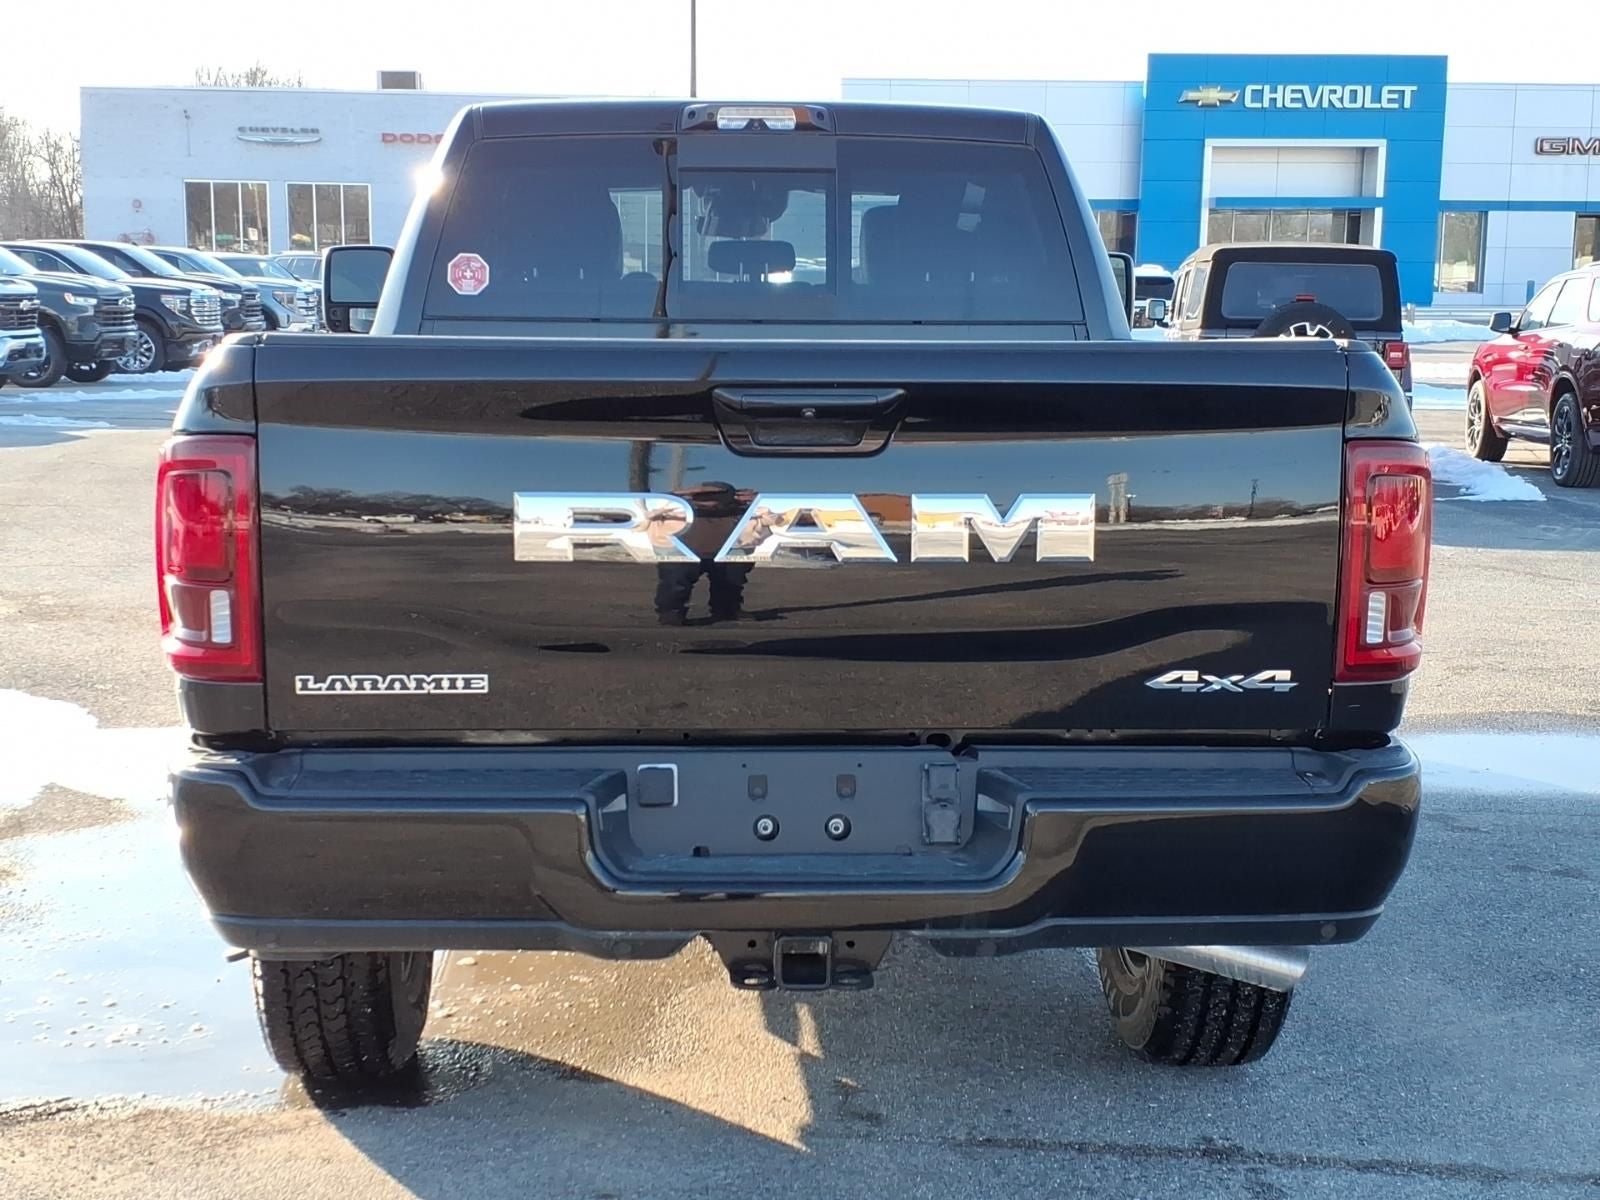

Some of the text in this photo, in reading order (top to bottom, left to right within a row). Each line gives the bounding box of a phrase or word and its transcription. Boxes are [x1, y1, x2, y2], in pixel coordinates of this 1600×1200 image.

[1244, 84, 1418, 109] CHEVROLET
[513, 492, 1096, 563] RAM
[295, 674, 489, 694] LARAMIE
[1144, 669, 1299, 693] 4x4
